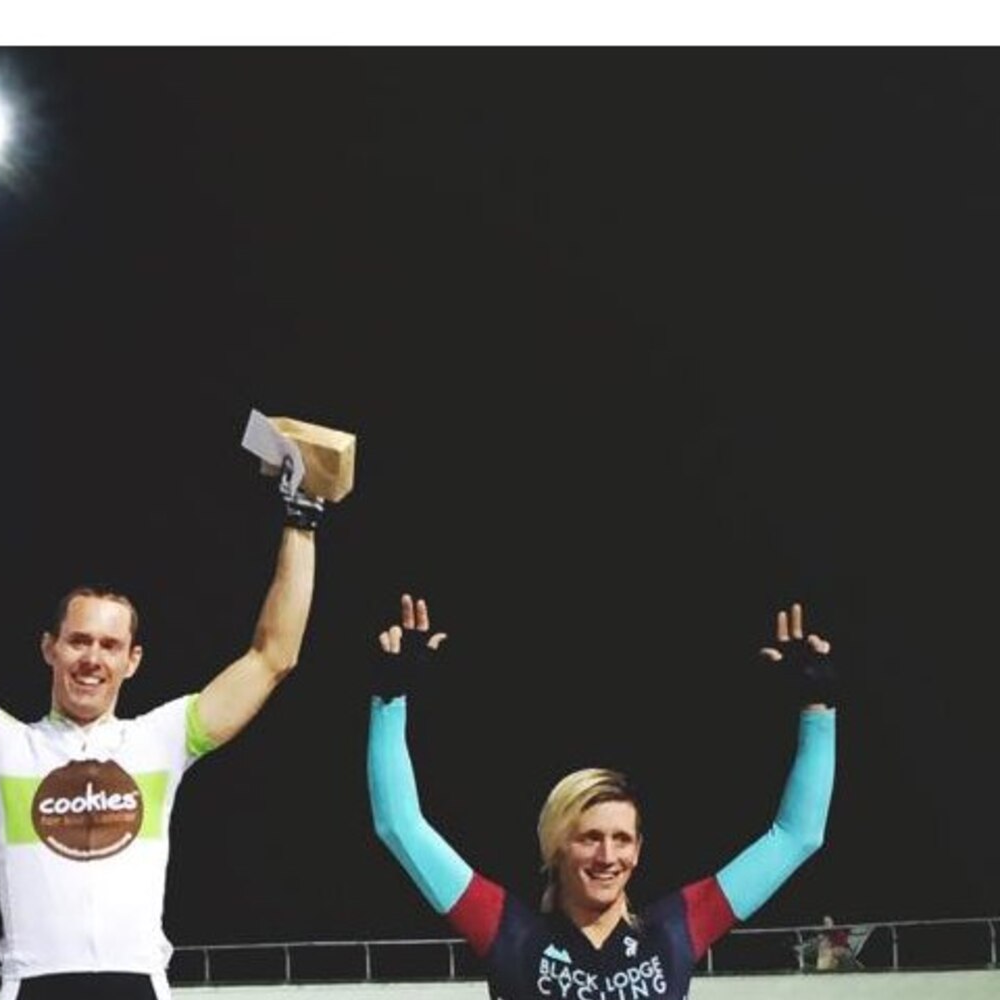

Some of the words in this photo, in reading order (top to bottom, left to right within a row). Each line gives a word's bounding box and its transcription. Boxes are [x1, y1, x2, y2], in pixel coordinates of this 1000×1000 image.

[39, 781, 136, 813] cookies
[539, 958, 599, 990] BLACK
[606, 956, 663, 991] LODGE
